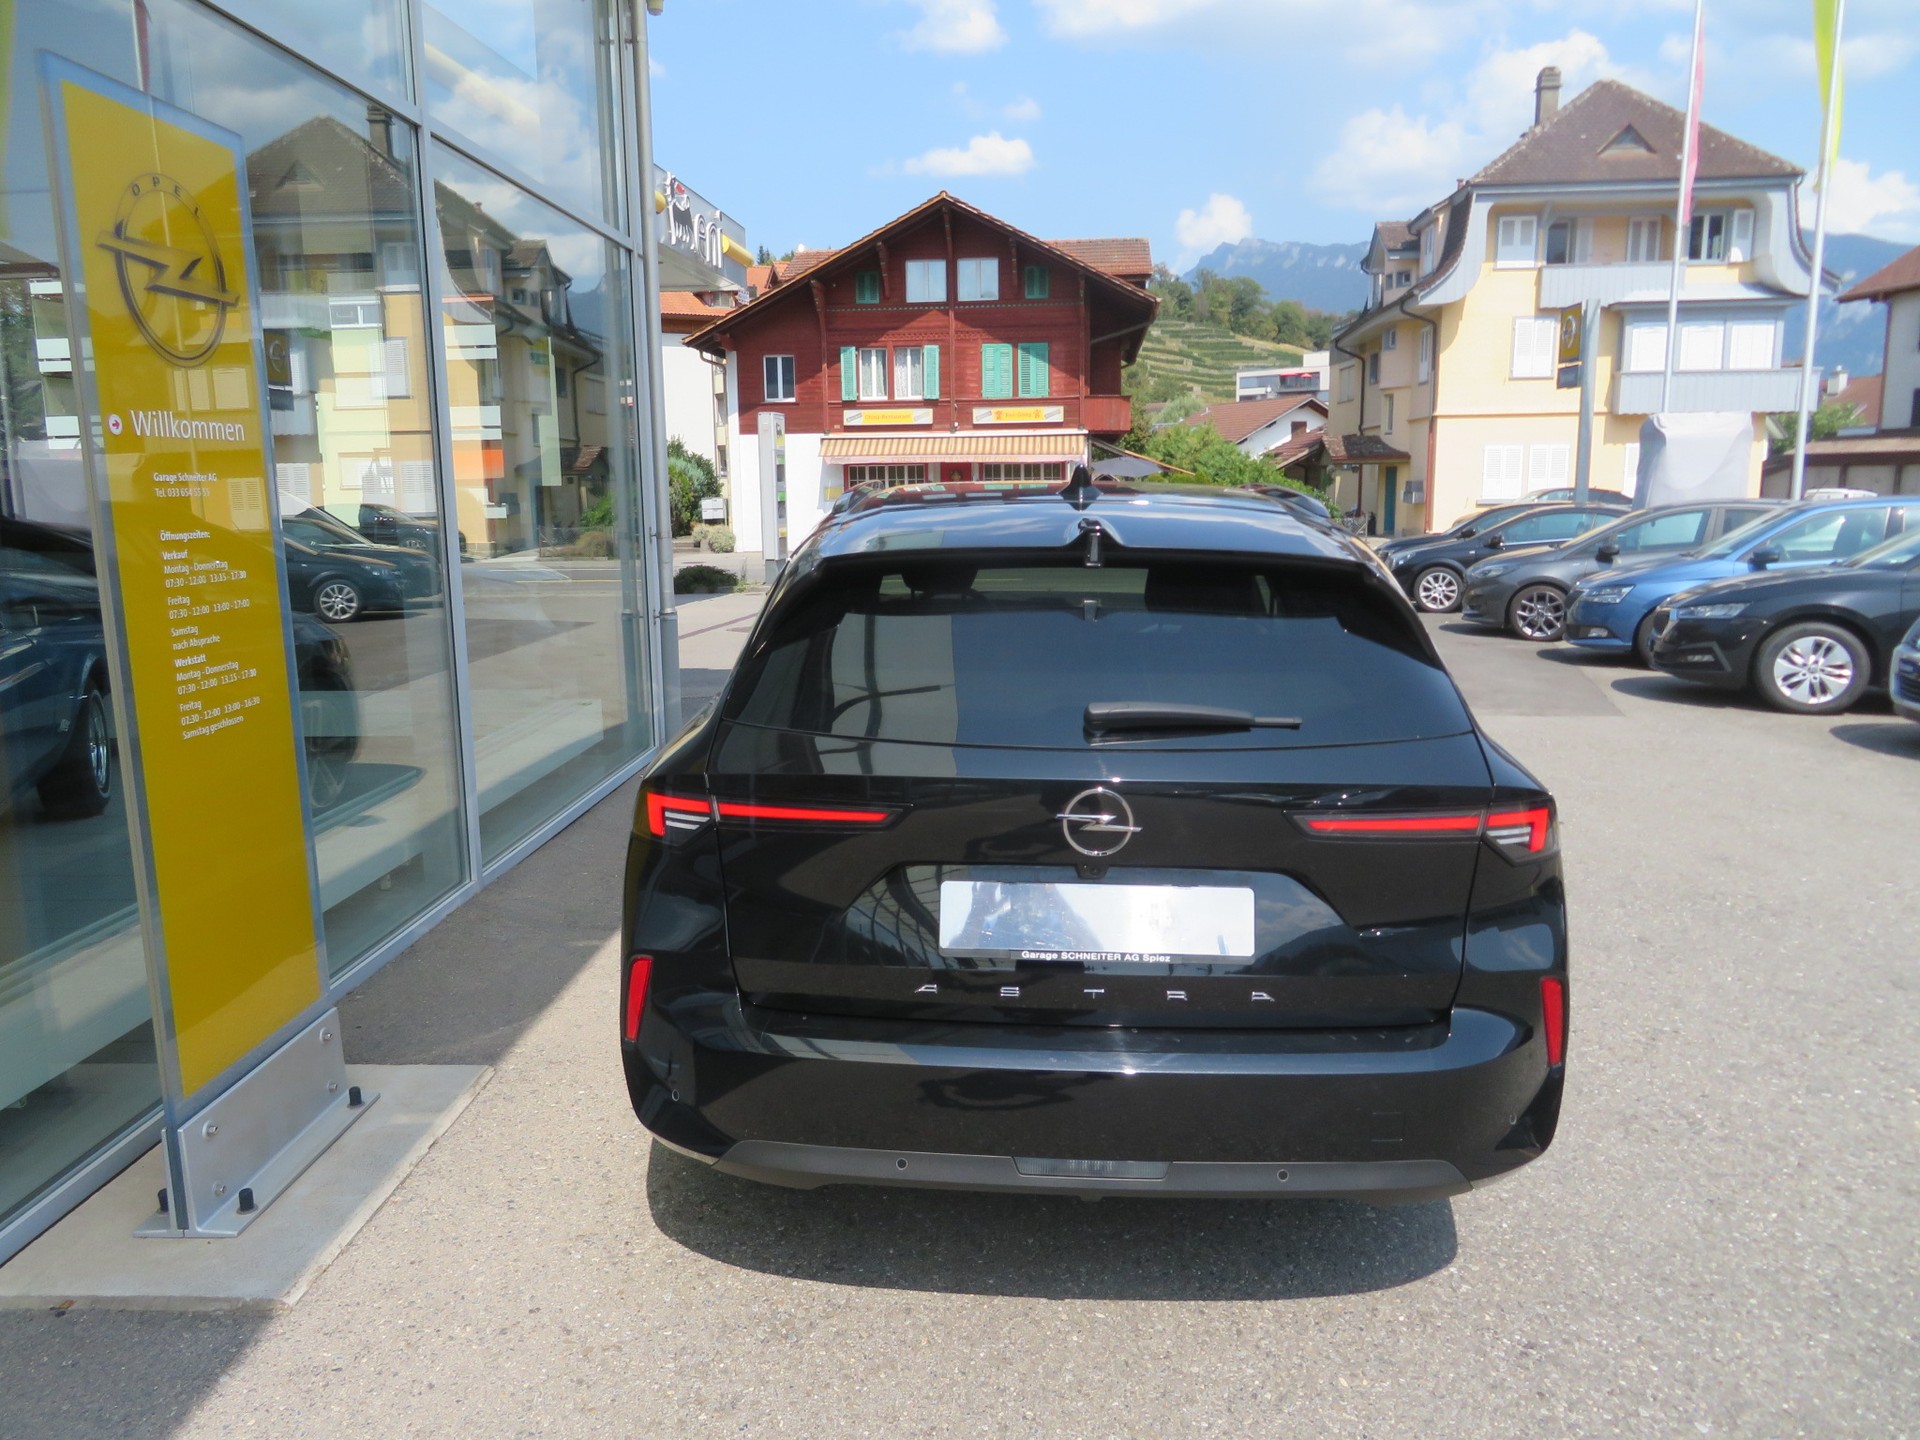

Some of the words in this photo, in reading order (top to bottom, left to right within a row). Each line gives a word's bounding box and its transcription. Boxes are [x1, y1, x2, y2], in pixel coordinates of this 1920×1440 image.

[131, 176, 199, 216] OPEL
[130, 410, 246, 441] Willkommen
[153, 472, 177, 484] Garage
[178, 473, 207, 482] Schneiter
[208, 473, 217, 482] AG
[155, 488, 166, 497] Tel.
[167, 488, 180, 497] 033
[181, 488, 192, 497] 654
[160, 529, 210, 542] Öffnungszeiten:
[162, 549, 188, 560] Verkauf
[164, 565, 189, 575] Montag
[194, 561, 228, 571] Donnerstag
[165, 578, 184, 588] 07:30
[189, 575, 206, 585] 12:00
[231, 570, 246, 580] 17:30
[168, 596, 190, 606] Freitag
[169, 609, 187, 619] 07:30
[192, 605, 209, 615] 12:00
[213, 602, 229, 612] 13:00
[234, 599, 250, 609] 17:00
[171, 626, 198, 637] Samstag
[173, 640, 188, 650] nach
[189, 634, 220, 648] Absprache
[174, 653, 206, 668] Werkstatt
[176, 670, 201, 681] Montag
[205, 661, 239, 675] Donnerstag
[177, 683, 196, 695] 07:30
[200, 678, 218, 690] 12:00
[241, 668, 257, 679] 17:30
[180, 700, 202, 712] Freitag
[181, 714, 199, 726] 07:30
[204, 708, 221, 719] 12:00
[224, 702, 241, 713] 13:00
[244, 696, 261, 708] 16:30
[182, 724, 210, 740] Samstag
[209, 715, 244, 734] geschlossen
[1021, 950, 1058, 961] Garage
[1060, 951, 1122, 962] SCHNEITER
[1124, 953, 1140, 962] AG
[1142, 953, 1171, 963] Spiez
[914, 983, 1276, 1003] ASTRA
